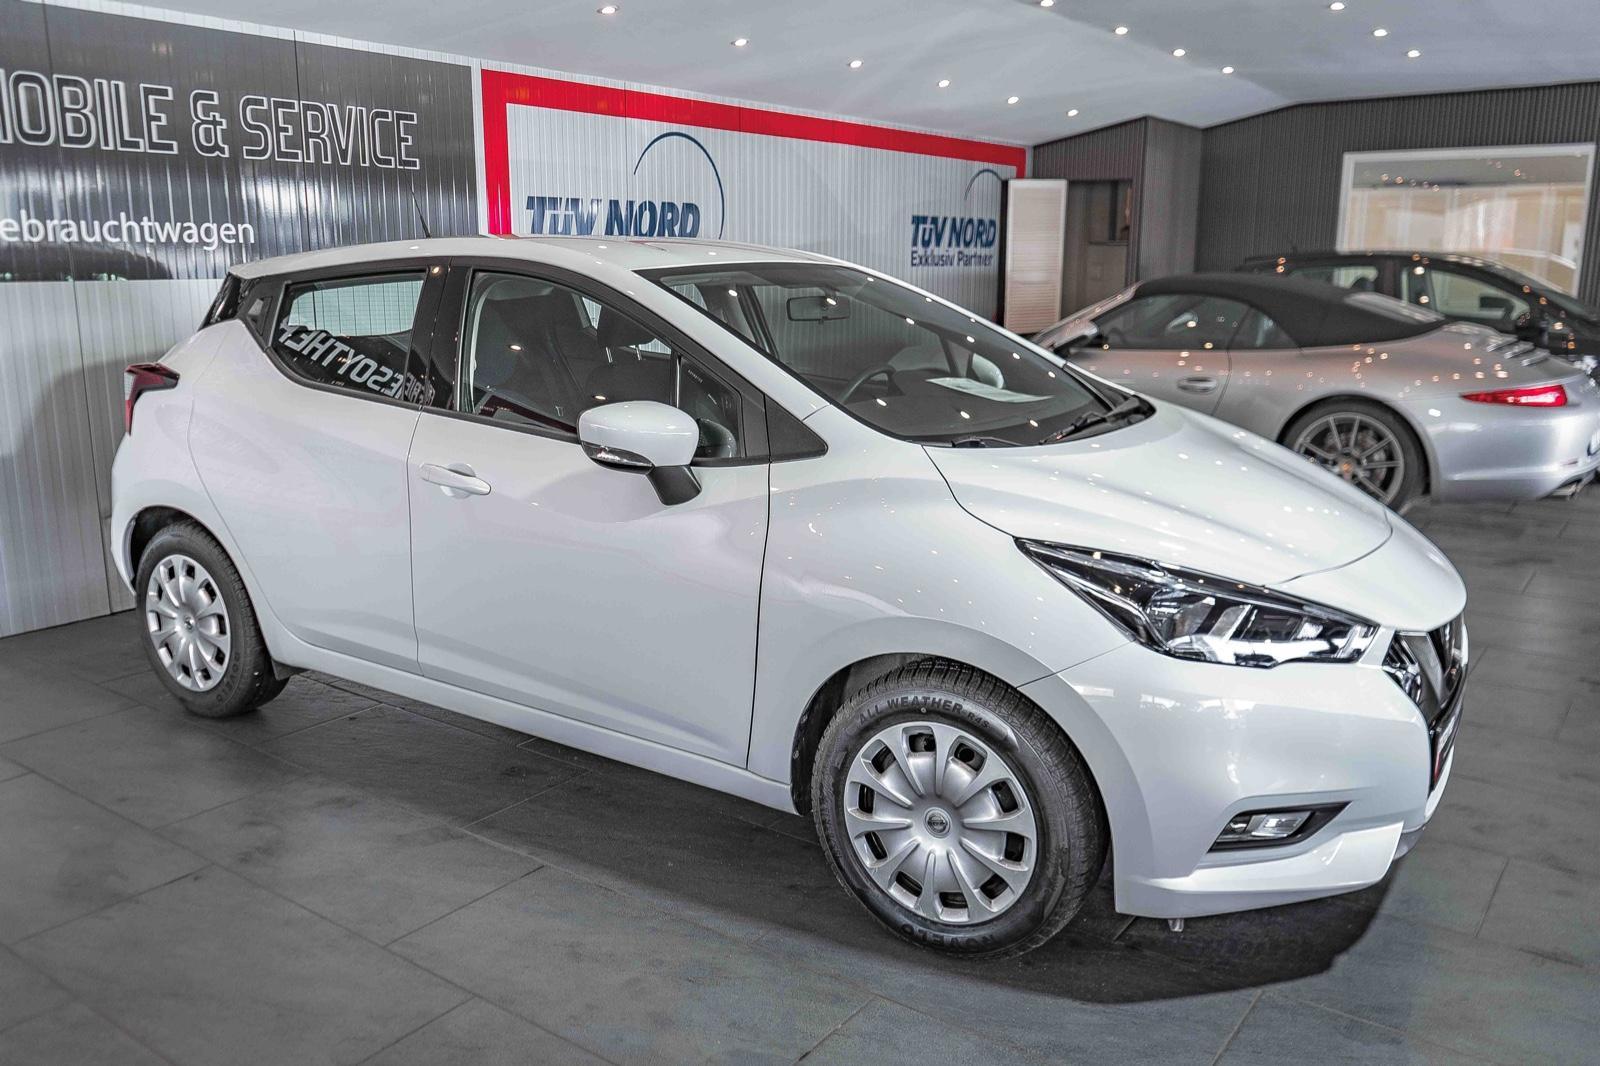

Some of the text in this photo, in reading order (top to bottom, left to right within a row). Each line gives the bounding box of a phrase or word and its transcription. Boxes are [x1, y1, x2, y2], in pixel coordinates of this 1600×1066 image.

[0, 68, 420, 170] OBILE & SERVICE
[0, 209, 254, 251] ebrauchtwagen
[604, 199, 700, 238] NORD
[948, 216, 996, 248] NORD
[911, 250, 992, 267] Exklusiv Partner
[858, 703, 881, 727] ALL
[886, 695, 964, 714] WEATHER
